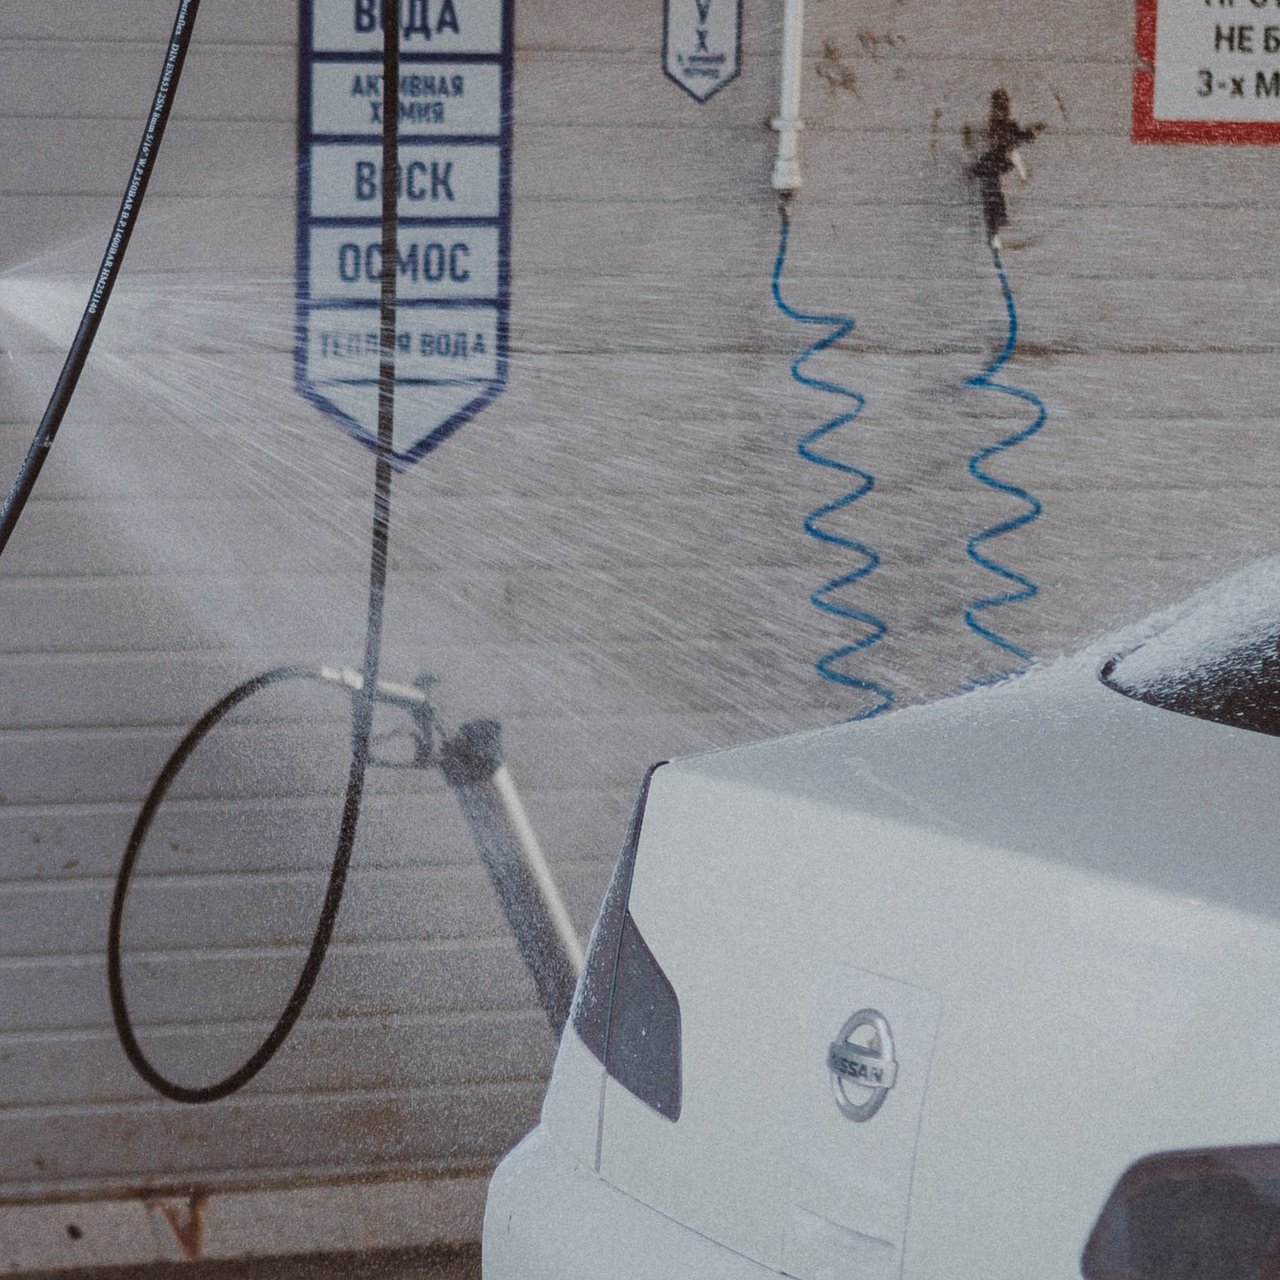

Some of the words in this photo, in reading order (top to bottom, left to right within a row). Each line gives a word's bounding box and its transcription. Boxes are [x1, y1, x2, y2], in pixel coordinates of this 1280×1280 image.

[167, 42, 180, 62] DIN
[1213, 24, 1254, 54] НЕ
[159, 62, 174, 92] EN853
[153, 92, 166, 112] 2SN
[369, 101, 445, 125] ХМИЯ
[147, 111, 161, 133] 8mm
[139, 132, 154, 157] 5/16"
[122, 156, 147, 211] W.P.350BAR
[355, 161, 455, 202] ВСК
[103, 210, 130, 269] B.P.1400BAR
[338, 243, 470, 284] ОСМОС
[87, 267, 110, 314] HM251140
[321, 331, 412, 358] ТЕПЛЯ
[420, 331, 486, 360] ВОДА
